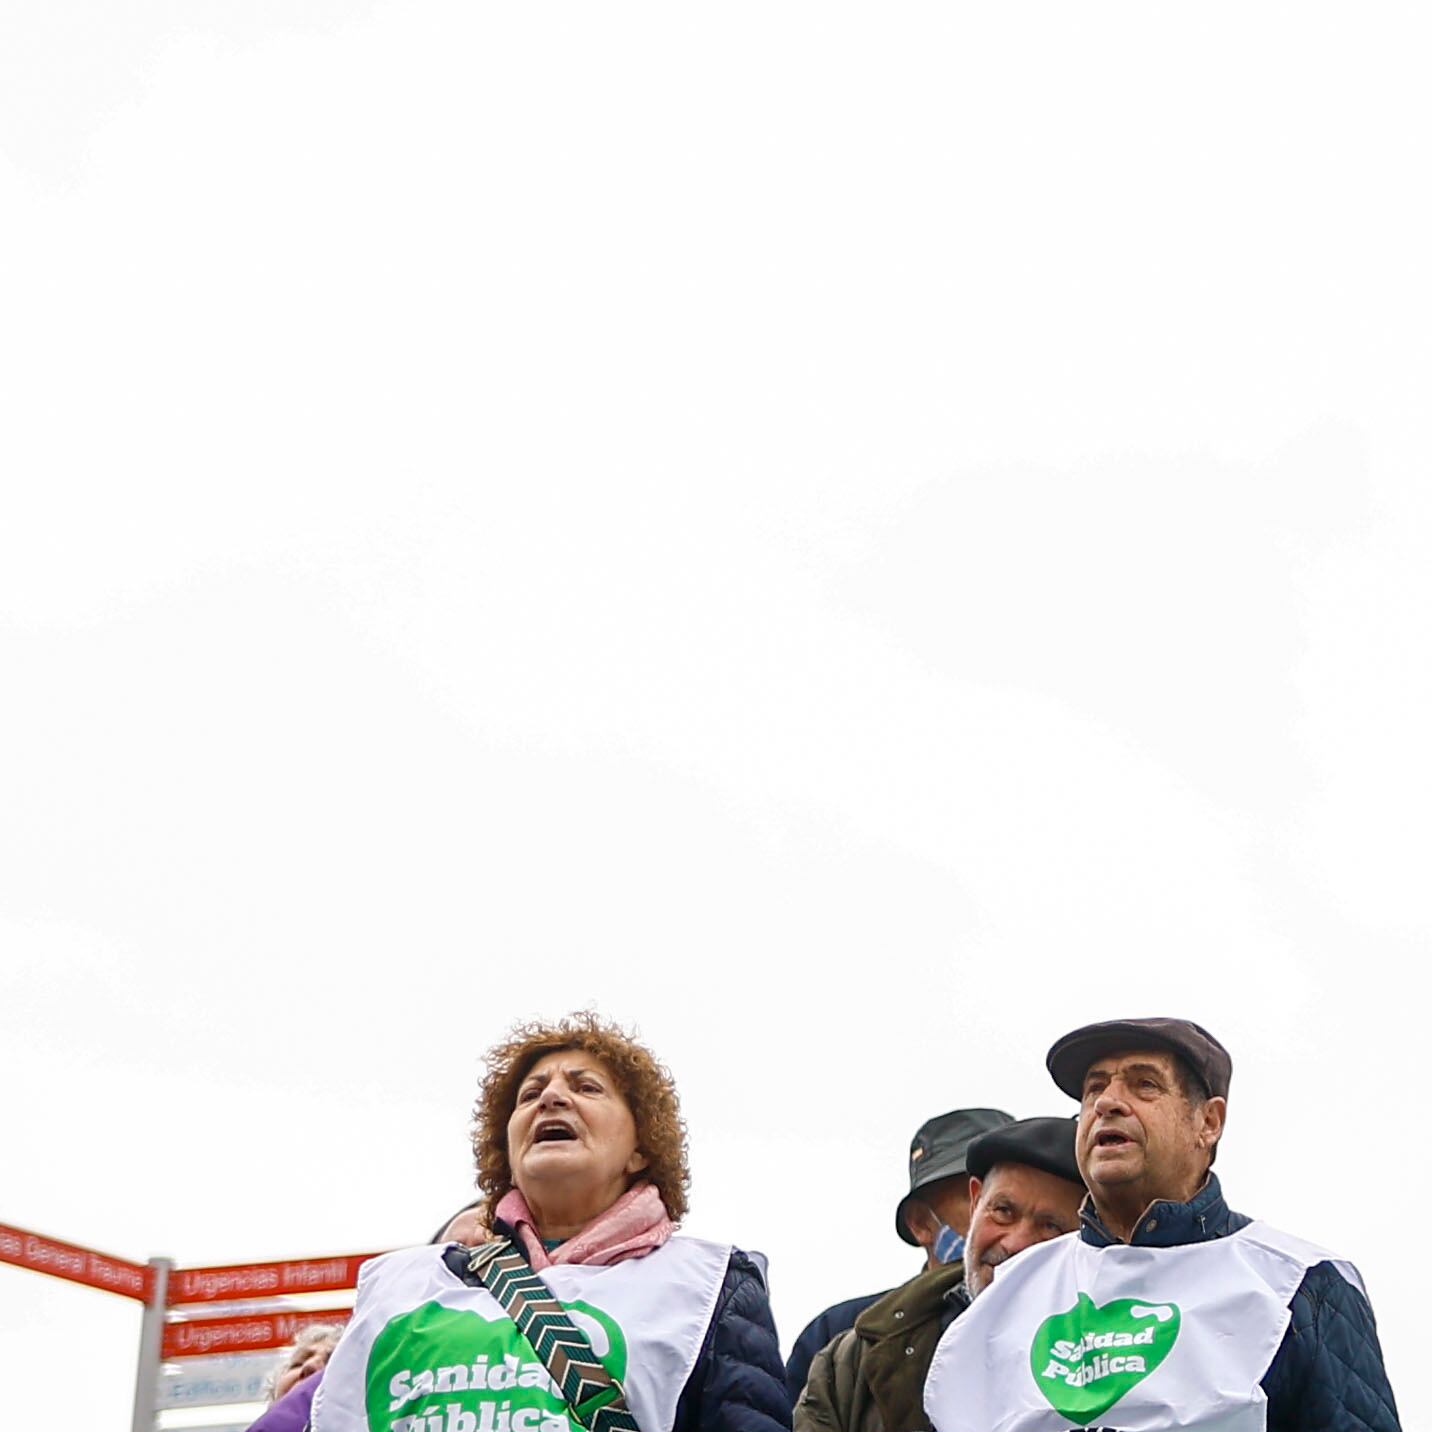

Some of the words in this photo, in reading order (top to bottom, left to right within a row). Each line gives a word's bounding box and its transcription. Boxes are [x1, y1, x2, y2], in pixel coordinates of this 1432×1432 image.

[182, 1268, 279, 1299] Urgencias
[282, 1260, 349, 1287] Infantil
[176, 1320, 273, 1352] Urgencias
